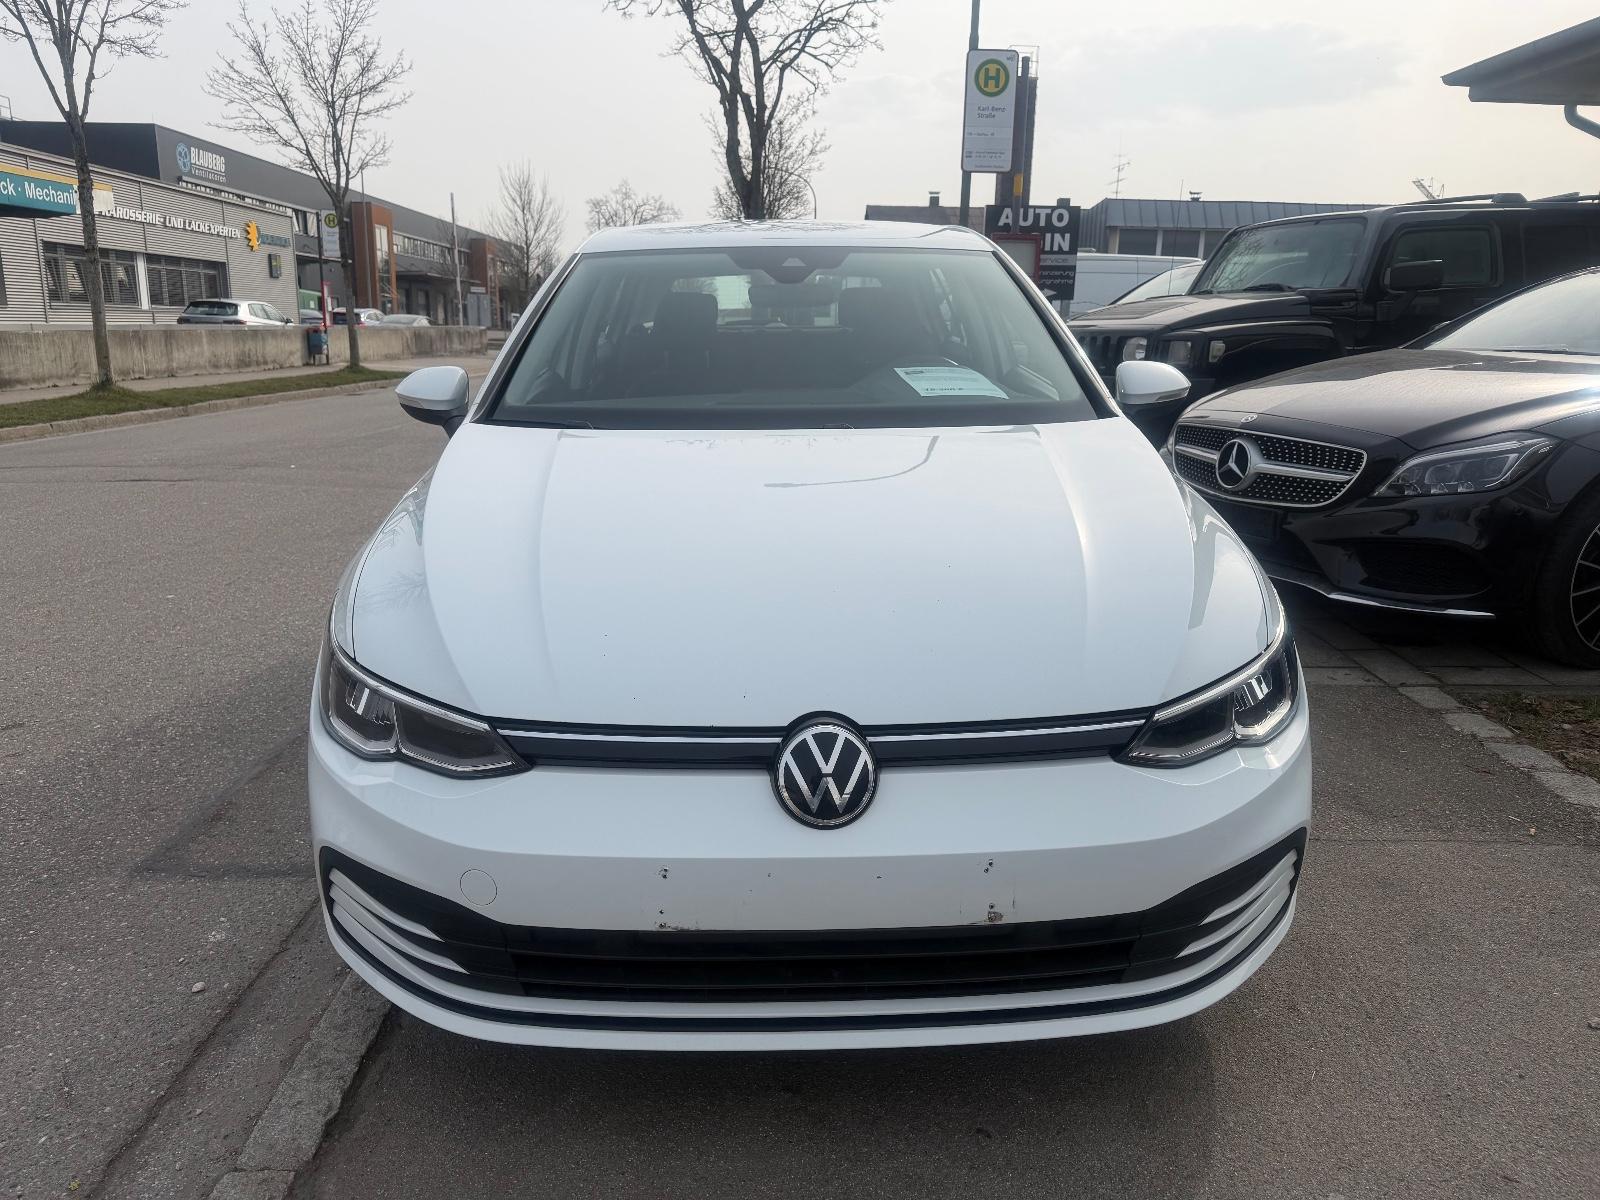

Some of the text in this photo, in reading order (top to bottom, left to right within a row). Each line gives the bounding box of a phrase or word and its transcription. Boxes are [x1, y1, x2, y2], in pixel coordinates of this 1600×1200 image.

[984, 67, 1000, 88] H
[191, 147, 225, 172] BLAUBERG
[0, 178, 16, 196] ck
[166, 216, 184, 229] UND
[186, 219, 240, 238] LACKEXPERTEN
[998, 207, 1070, 227] AUTO
[1041, 233, 1070, 251] IN
